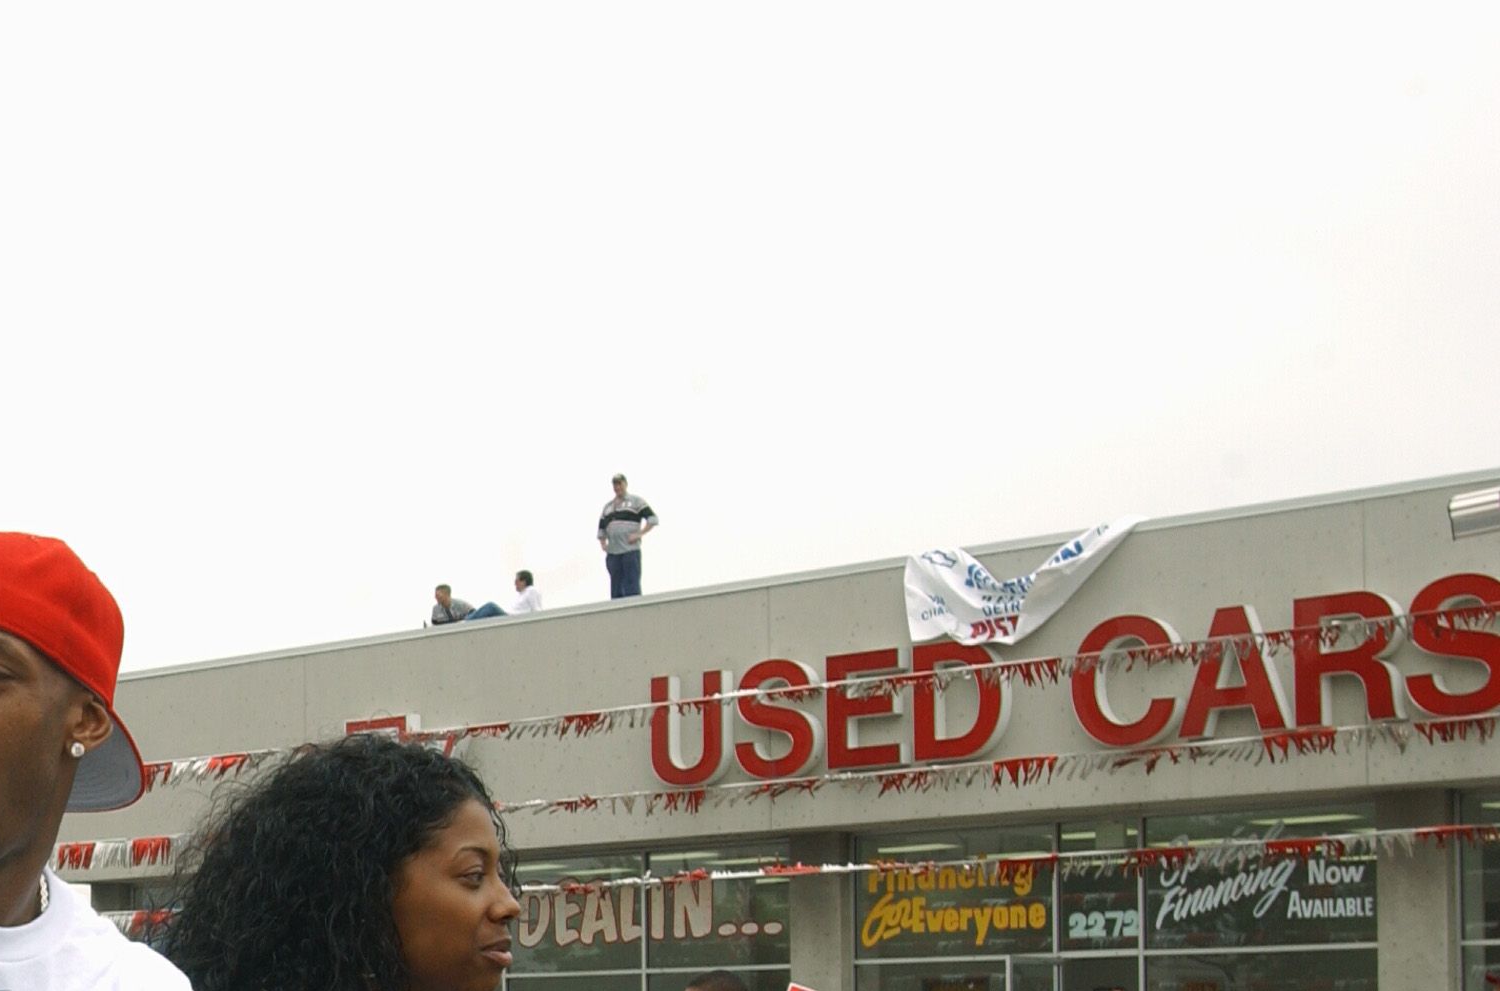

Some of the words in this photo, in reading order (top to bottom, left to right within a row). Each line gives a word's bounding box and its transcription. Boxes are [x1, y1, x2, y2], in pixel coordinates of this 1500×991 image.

[970, 616, 1020, 641] PIST
[650, 640, 1012, 789] USED
[1070, 572, 1500, 749] CARS
[1155, 856, 1297, 931] Financing
[911, 896, 1047, 946] Everyone
[1068, 909, 1139, 939] 2272
